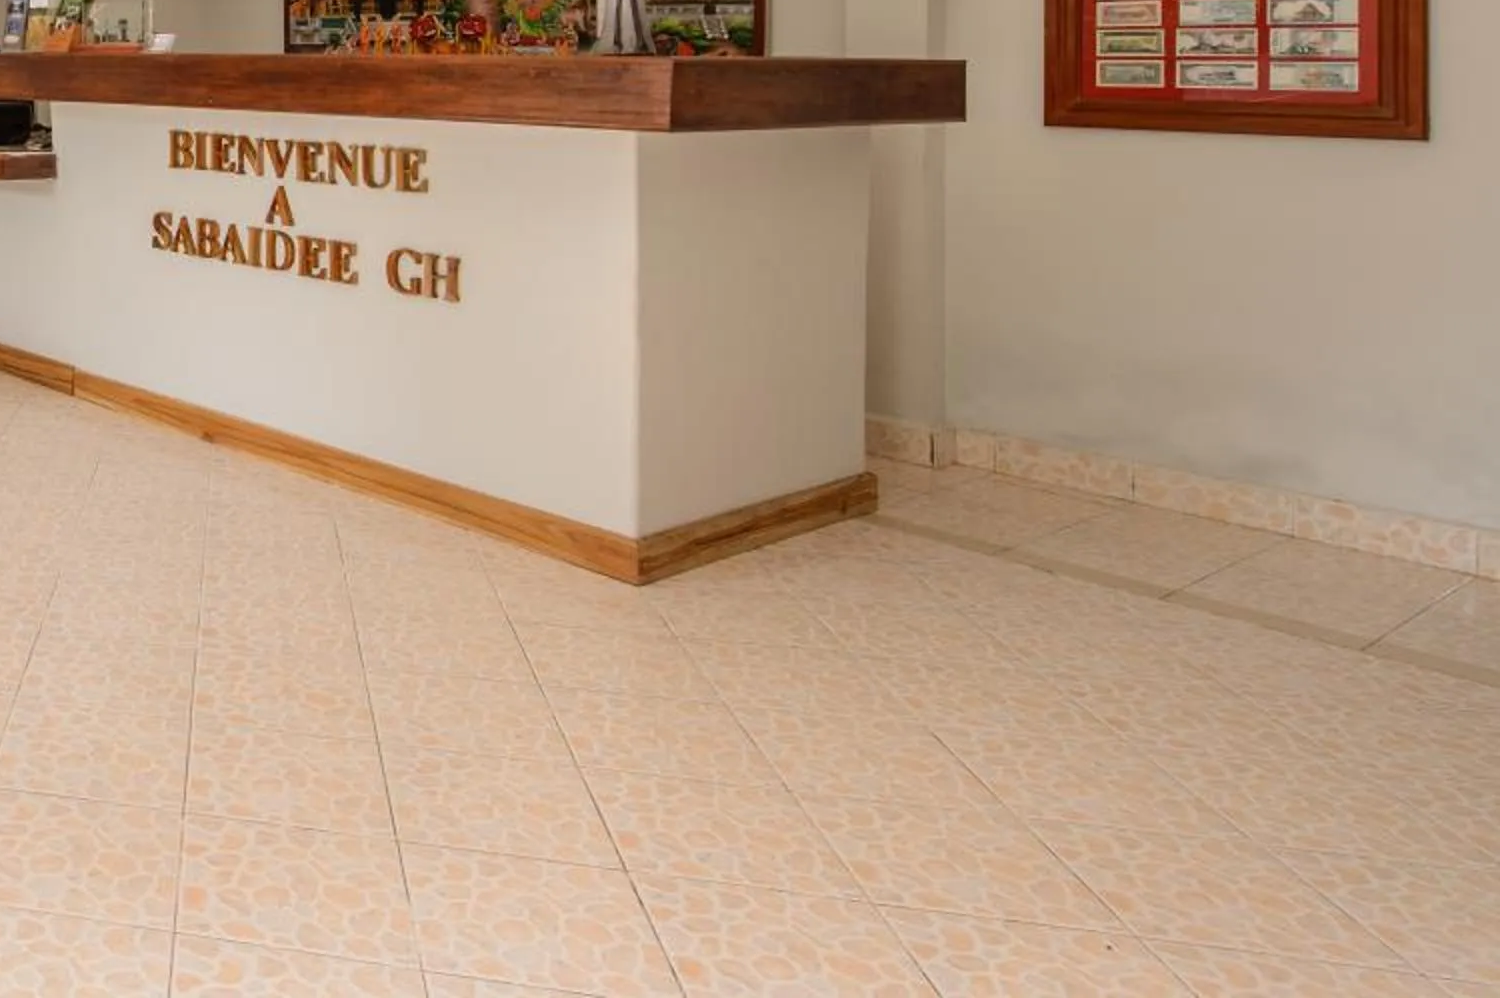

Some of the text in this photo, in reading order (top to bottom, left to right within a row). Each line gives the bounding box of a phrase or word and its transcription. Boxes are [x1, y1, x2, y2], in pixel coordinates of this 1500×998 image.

[168, 129, 429, 194] BIENVENUE
[265, 185, 295, 227] A
[151, 211, 462, 302] SABAIDEE GH
